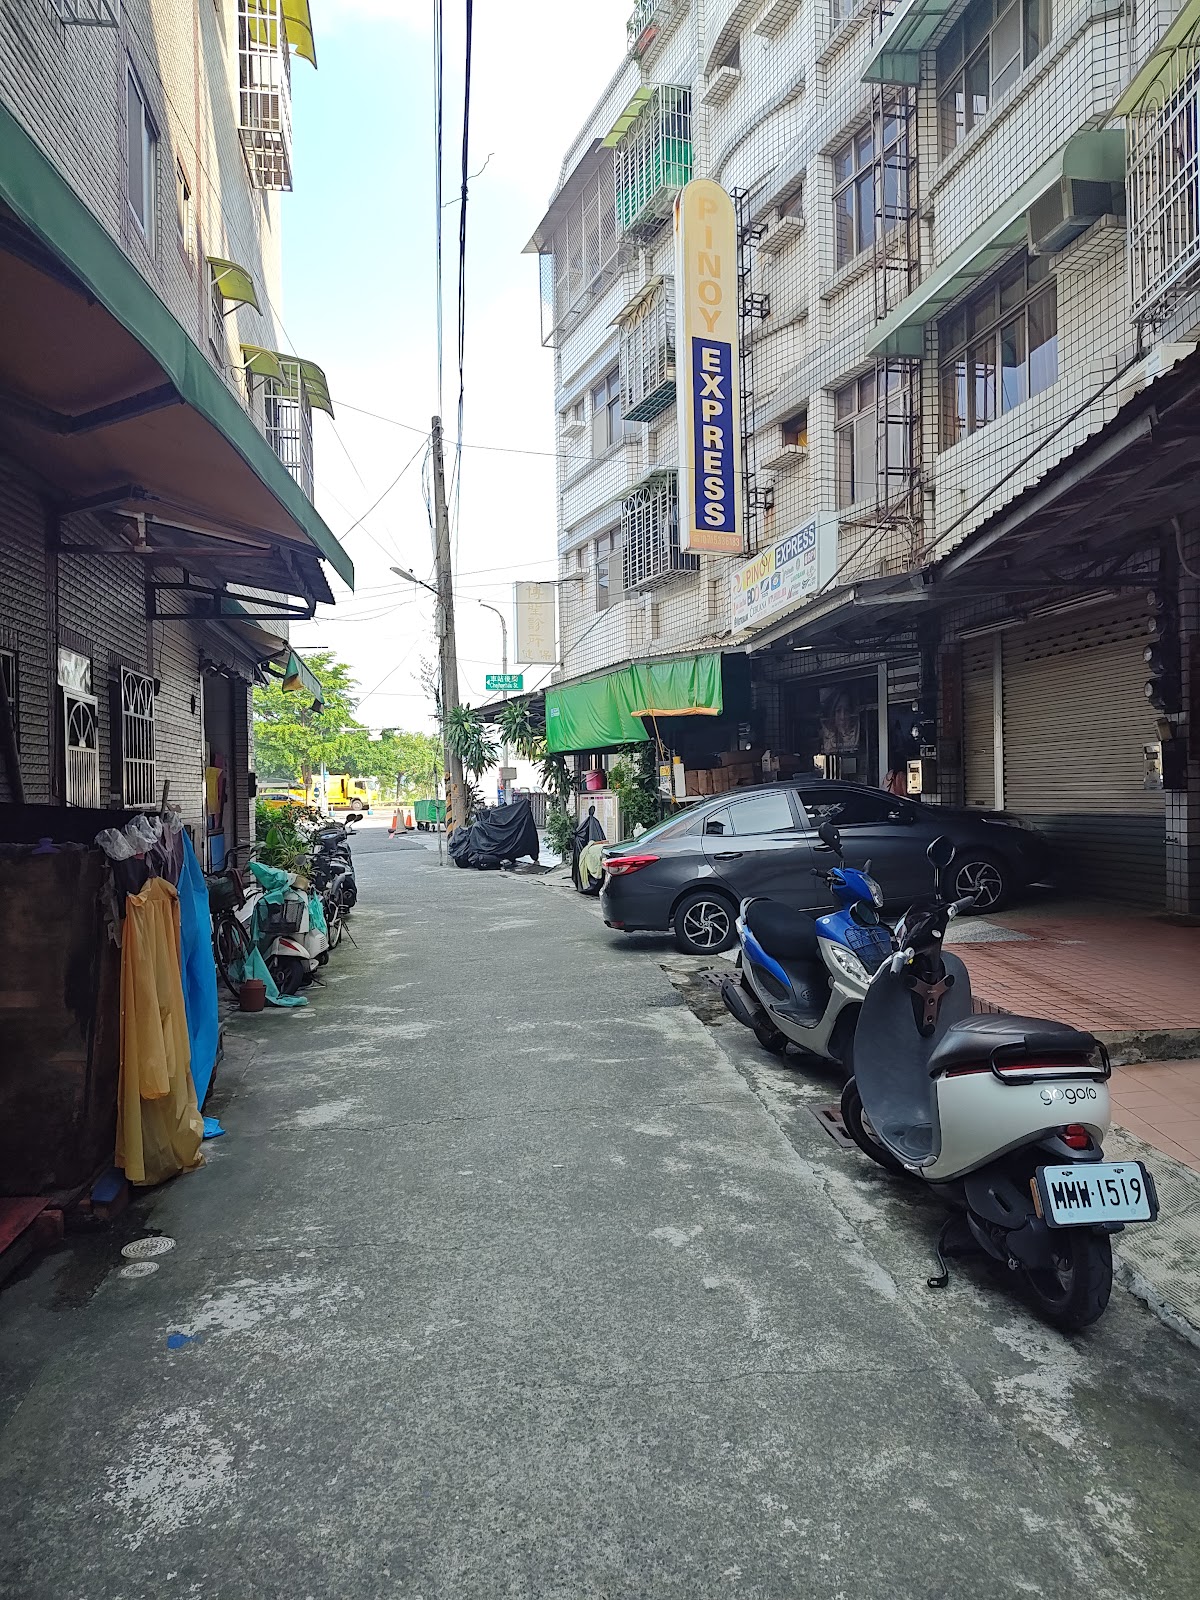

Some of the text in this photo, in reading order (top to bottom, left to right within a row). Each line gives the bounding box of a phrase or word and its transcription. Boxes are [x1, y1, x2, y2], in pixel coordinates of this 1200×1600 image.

[698, 196, 726, 527] PINOY EXPRESS
[745, 524, 816, 587] PINOY EXPRESS
